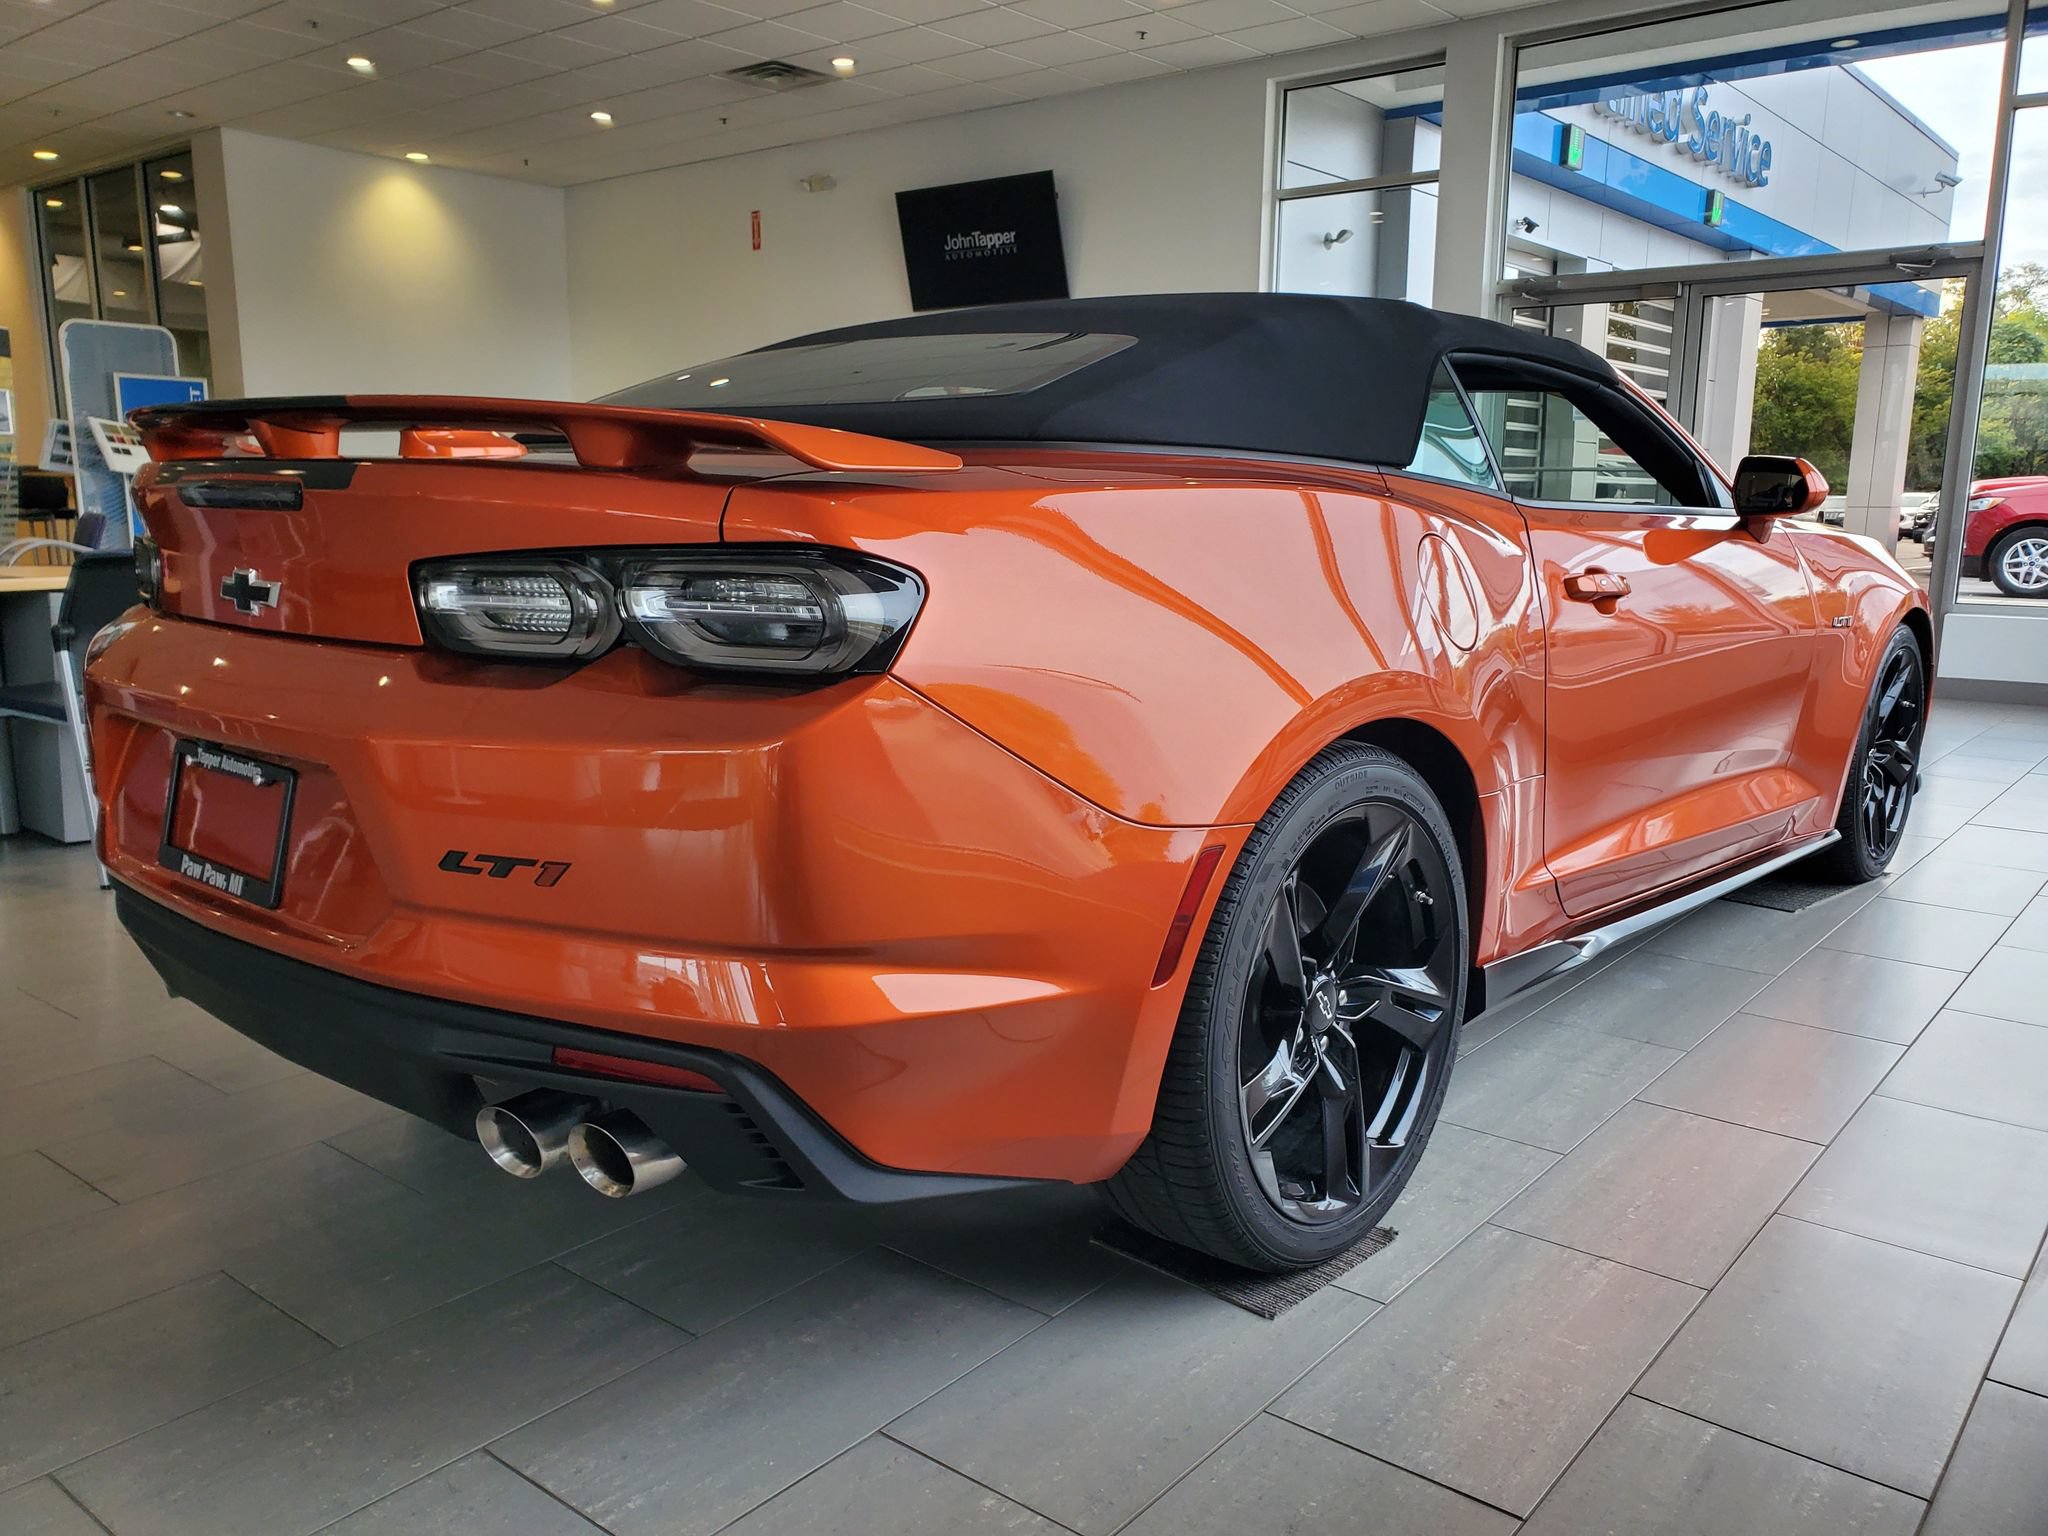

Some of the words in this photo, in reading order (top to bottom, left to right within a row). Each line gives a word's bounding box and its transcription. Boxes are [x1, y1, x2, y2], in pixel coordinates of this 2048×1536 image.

[1687, 86, 1772, 187] Service
[198, 747, 221, 769] Tapper
[221, 754, 262, 777] Automotive
[1334, 770, 1367, 790] OUTSIDE
[181, 854, 203, 880] Paw
[203, 862, 227, 890] Paw,
[229, 873, 244, 896] MI
[438, 850, 573, 887] LT1
